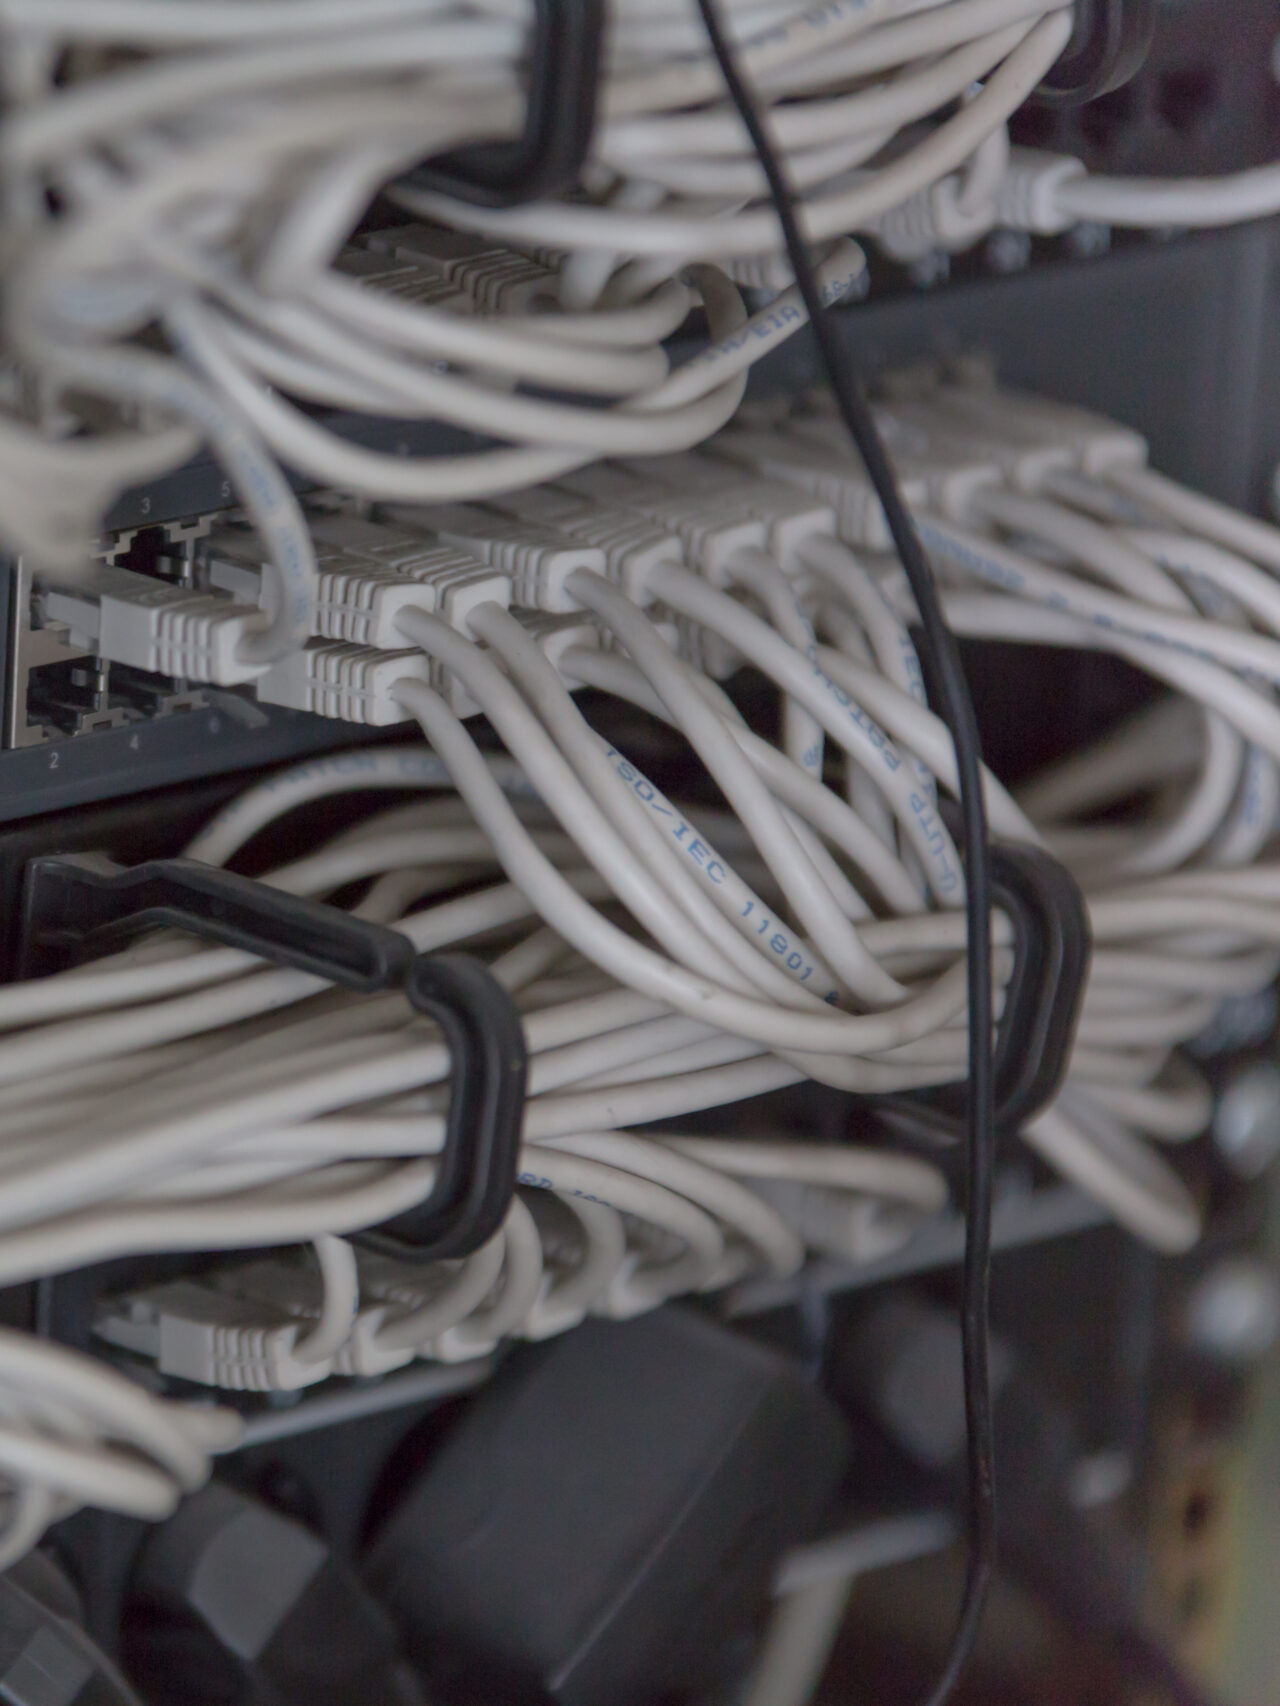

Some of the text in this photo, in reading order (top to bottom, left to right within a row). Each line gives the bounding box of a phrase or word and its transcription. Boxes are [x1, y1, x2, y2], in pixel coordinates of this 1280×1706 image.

[221, 480, 231, 498] 5
[141, 497, 151, 514] 3
[129, 734, 139, 750] 4
[49, 752, 59, 769] 2
[740, 900, 814, 982] 11801
